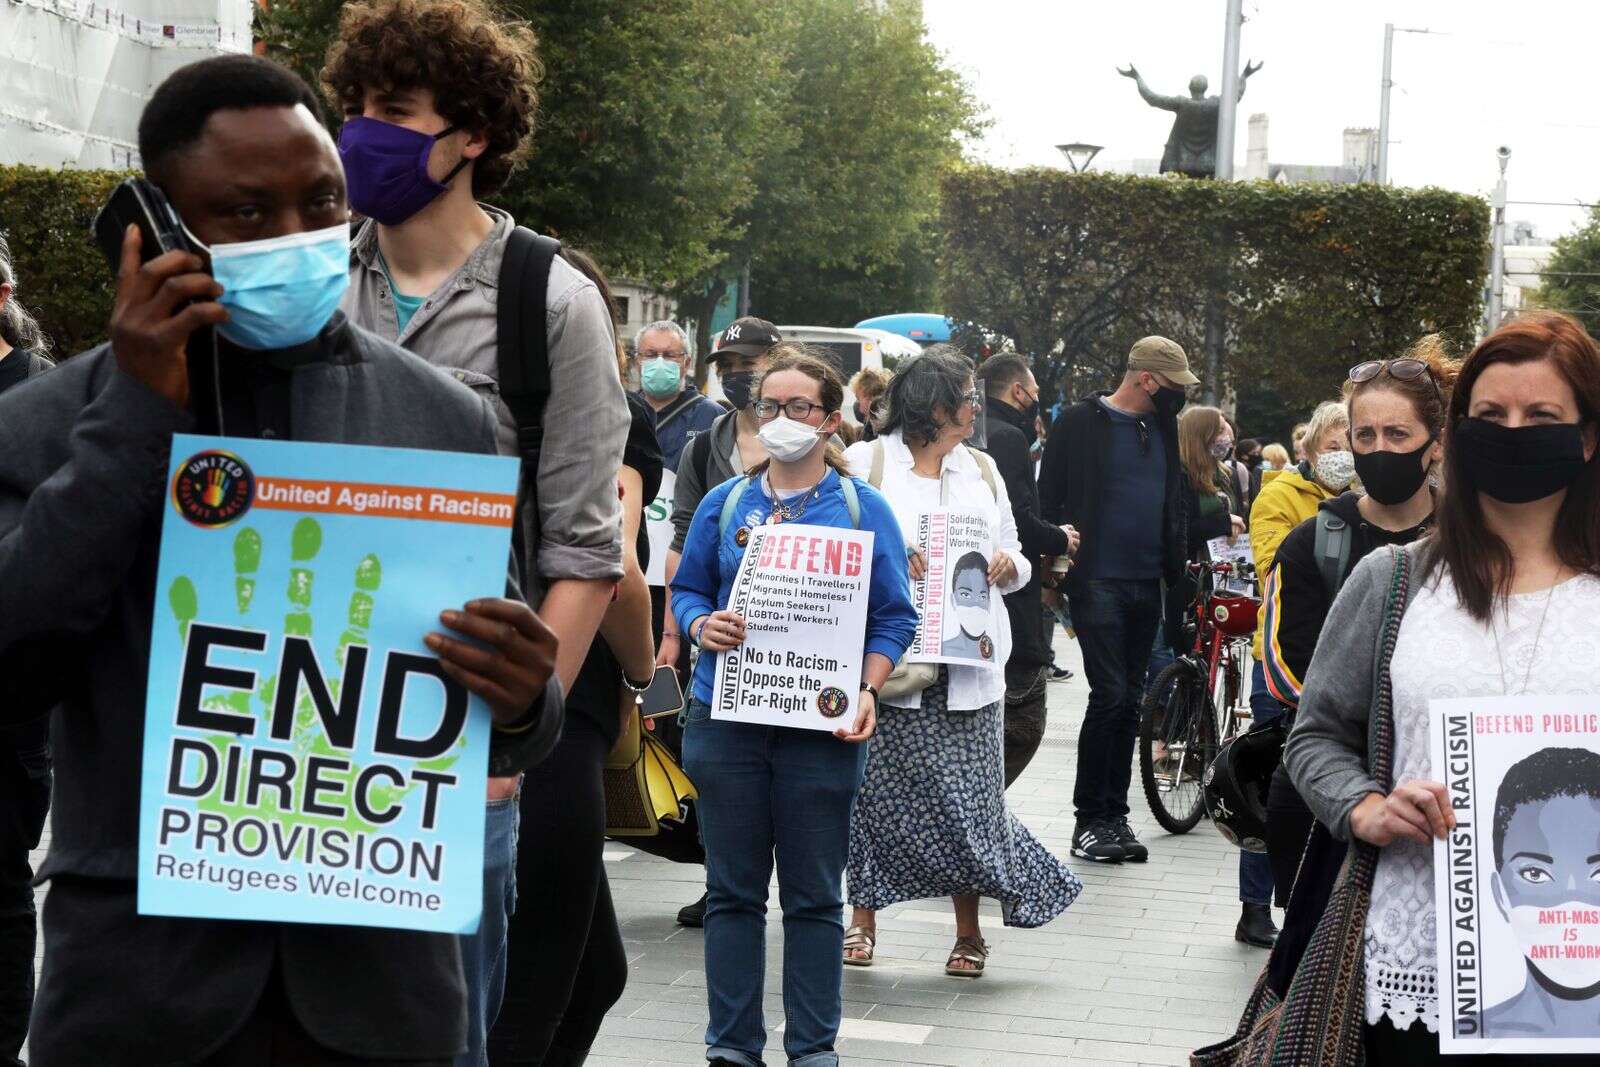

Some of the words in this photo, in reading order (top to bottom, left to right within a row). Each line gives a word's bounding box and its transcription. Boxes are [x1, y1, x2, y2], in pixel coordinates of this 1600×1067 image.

[189, 457, 244, 478] UNITED
[257, 482, 331, 505] United
[336, 488, 423, 512] Against
[429, 494, 512, 519] Racism
[919, 514, 929, 551] ACISM
[930, 513, 946, 558] HEALTH
[950, 526, 963, 536] Our
[759, 535, 863, 577] DEFEND
[753, 585, 792, 597] Migrants
[800, 590, 847, 601] Homeless
[756, 572, 800, 584] Minorities
[808, 577, 855, 590] Travellers
[928, 564, 943, 605] PUBLIC
[722, 655, 738, 710] UNITED
[741, 533, 764, 585] RACISM
[749, 610, 785, 621] LGBTQ+
[793, 614, 833, 625] Workers
[750, 597, 784, 609] Asylum
[786, 600, 825, 612] Seekers
[747, 622, 789, 633] Students
[925, 611, 940, 654] DEFEND
[745, 647, 763, 664] No
[769, 650, 781, 666] to
[786, 651, 838, 672] Racism
[176, 623, 469, 759] END
[743, 668, 794, 691] Oppose
[800, 675, 821, 692] the
[741, 690, 807, 713] Far-Right
[1476, 715, 1533, 734] DEFEND
[1543, 714, 1598, 733] PUBLIC
[1448, 715, 1471, 810] RACISM
[167, 738, 457, 830] DIRECT
[159, 808, 442, 881] PROVISION
[156, 854, 298, 892] Refugees
[308, 872, 441, 911] Welcome
[1452, 822, 1475, 932] AGAINST
[1538, 910, 1600, 924] ANTI-MAS
[1563, 928, 1578, 941] IS
[1456, 940, 1478, 1035] UNITED
